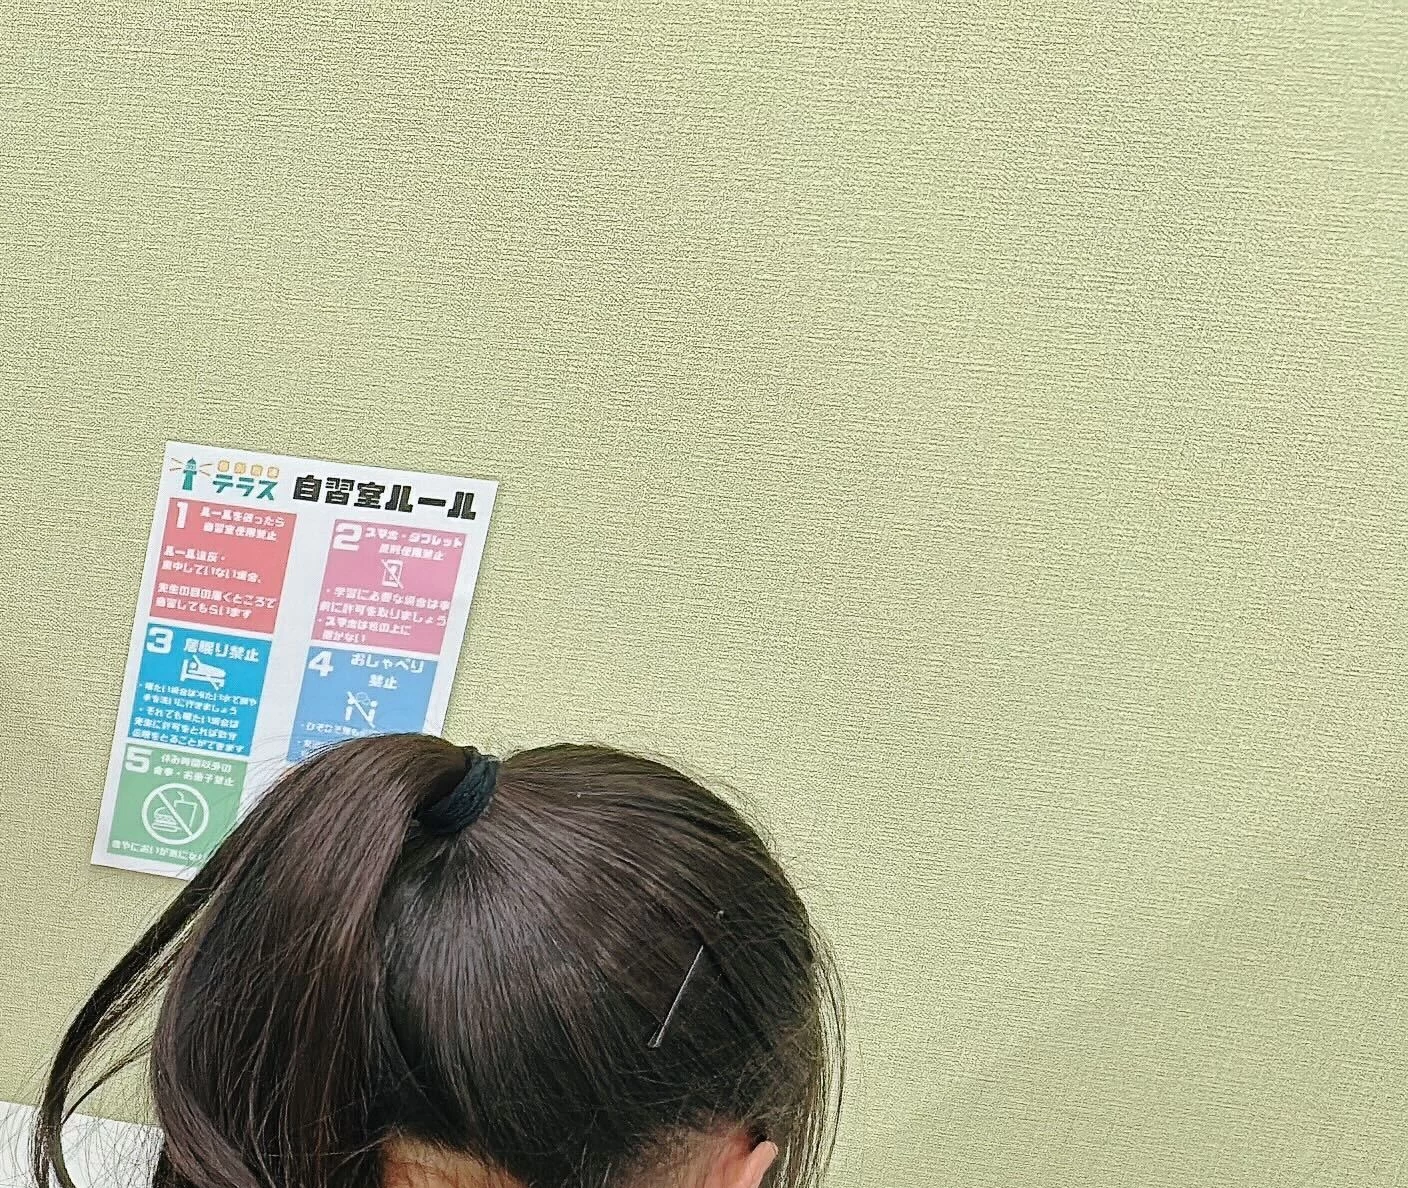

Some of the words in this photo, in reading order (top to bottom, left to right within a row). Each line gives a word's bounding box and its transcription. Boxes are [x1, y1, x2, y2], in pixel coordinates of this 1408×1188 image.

[212, 473, 279, 500] テラス
[292, 474, 477, 521] 自習室ルール
[176, 501, 189, 529] 1
[333, 522, 363, 551] 2
[146, 626, 174, 654] 3
[183, 638, 259, 662] 居眠り禁止
[307, 650, 334, 677] 4
[350, 652, 425, 674] おしゃべり
[368, 674, 398, 690] 禁止
[125, 746, 153, 773] 5
